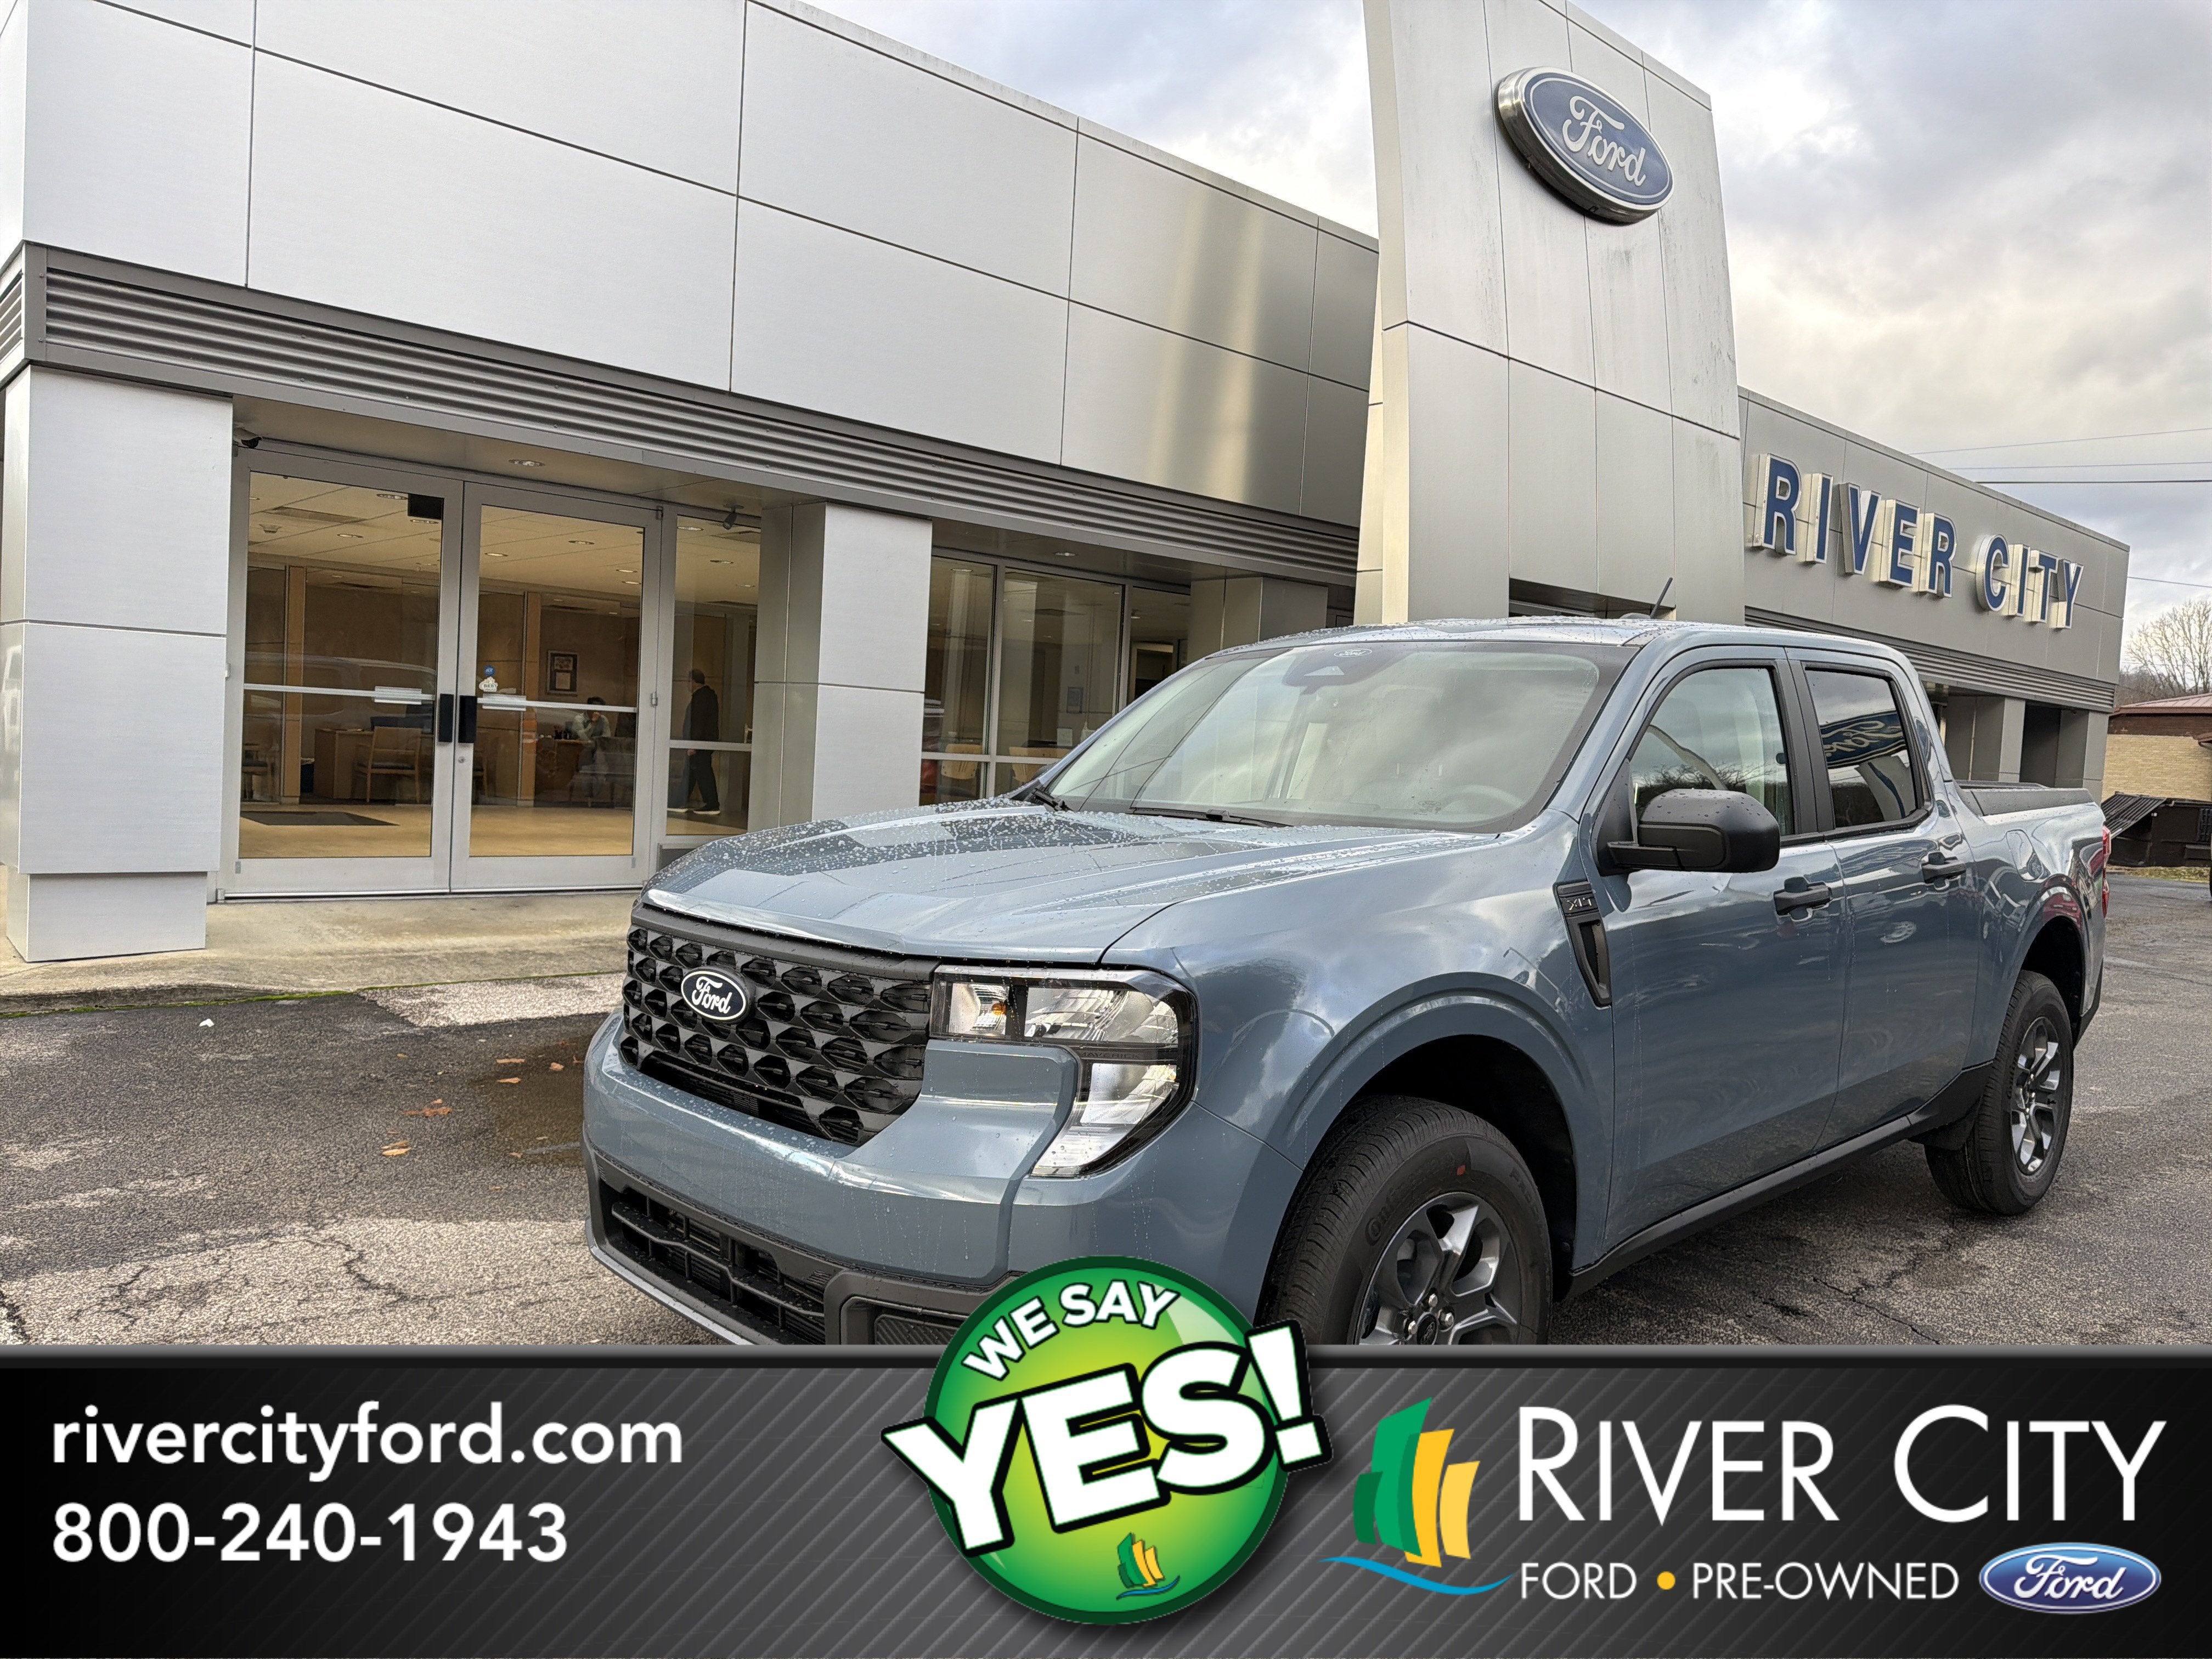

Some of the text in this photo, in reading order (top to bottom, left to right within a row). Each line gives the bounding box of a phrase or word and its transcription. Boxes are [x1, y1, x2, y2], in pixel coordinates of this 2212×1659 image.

[1562, 95, 1646, 187] Ford
[1757, 453, 2084, 629] RIVER CITY
[691, 976, 733, 1014] Ford
